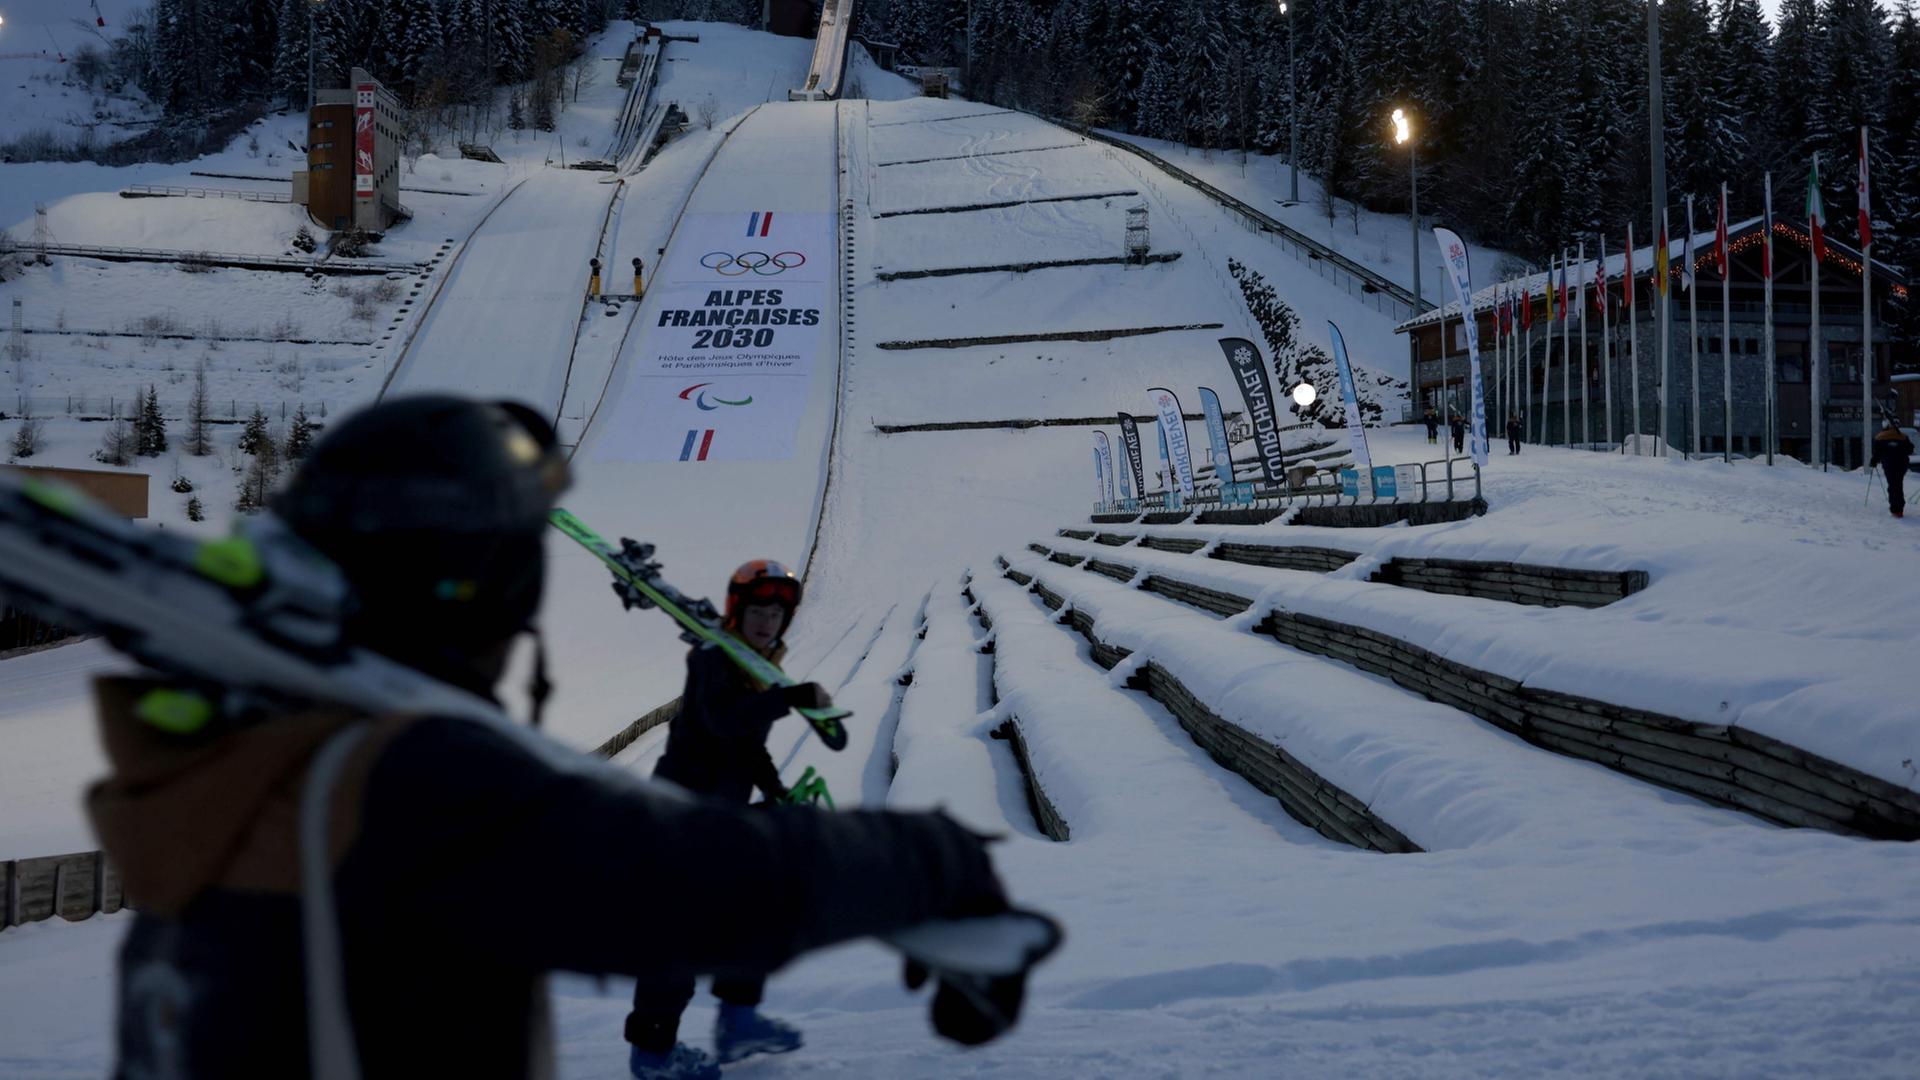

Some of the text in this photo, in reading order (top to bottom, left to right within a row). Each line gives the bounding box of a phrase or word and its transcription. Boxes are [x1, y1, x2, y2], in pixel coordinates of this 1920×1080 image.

[704, 289, 783, 307] ALPES
[657, 308, 820, 329] FRANÇAISES
[691, 327, 774, 350] 2030
[675, 360, 753, 369] Paralympiques
[736, 353, 801, 361] Olympiques
